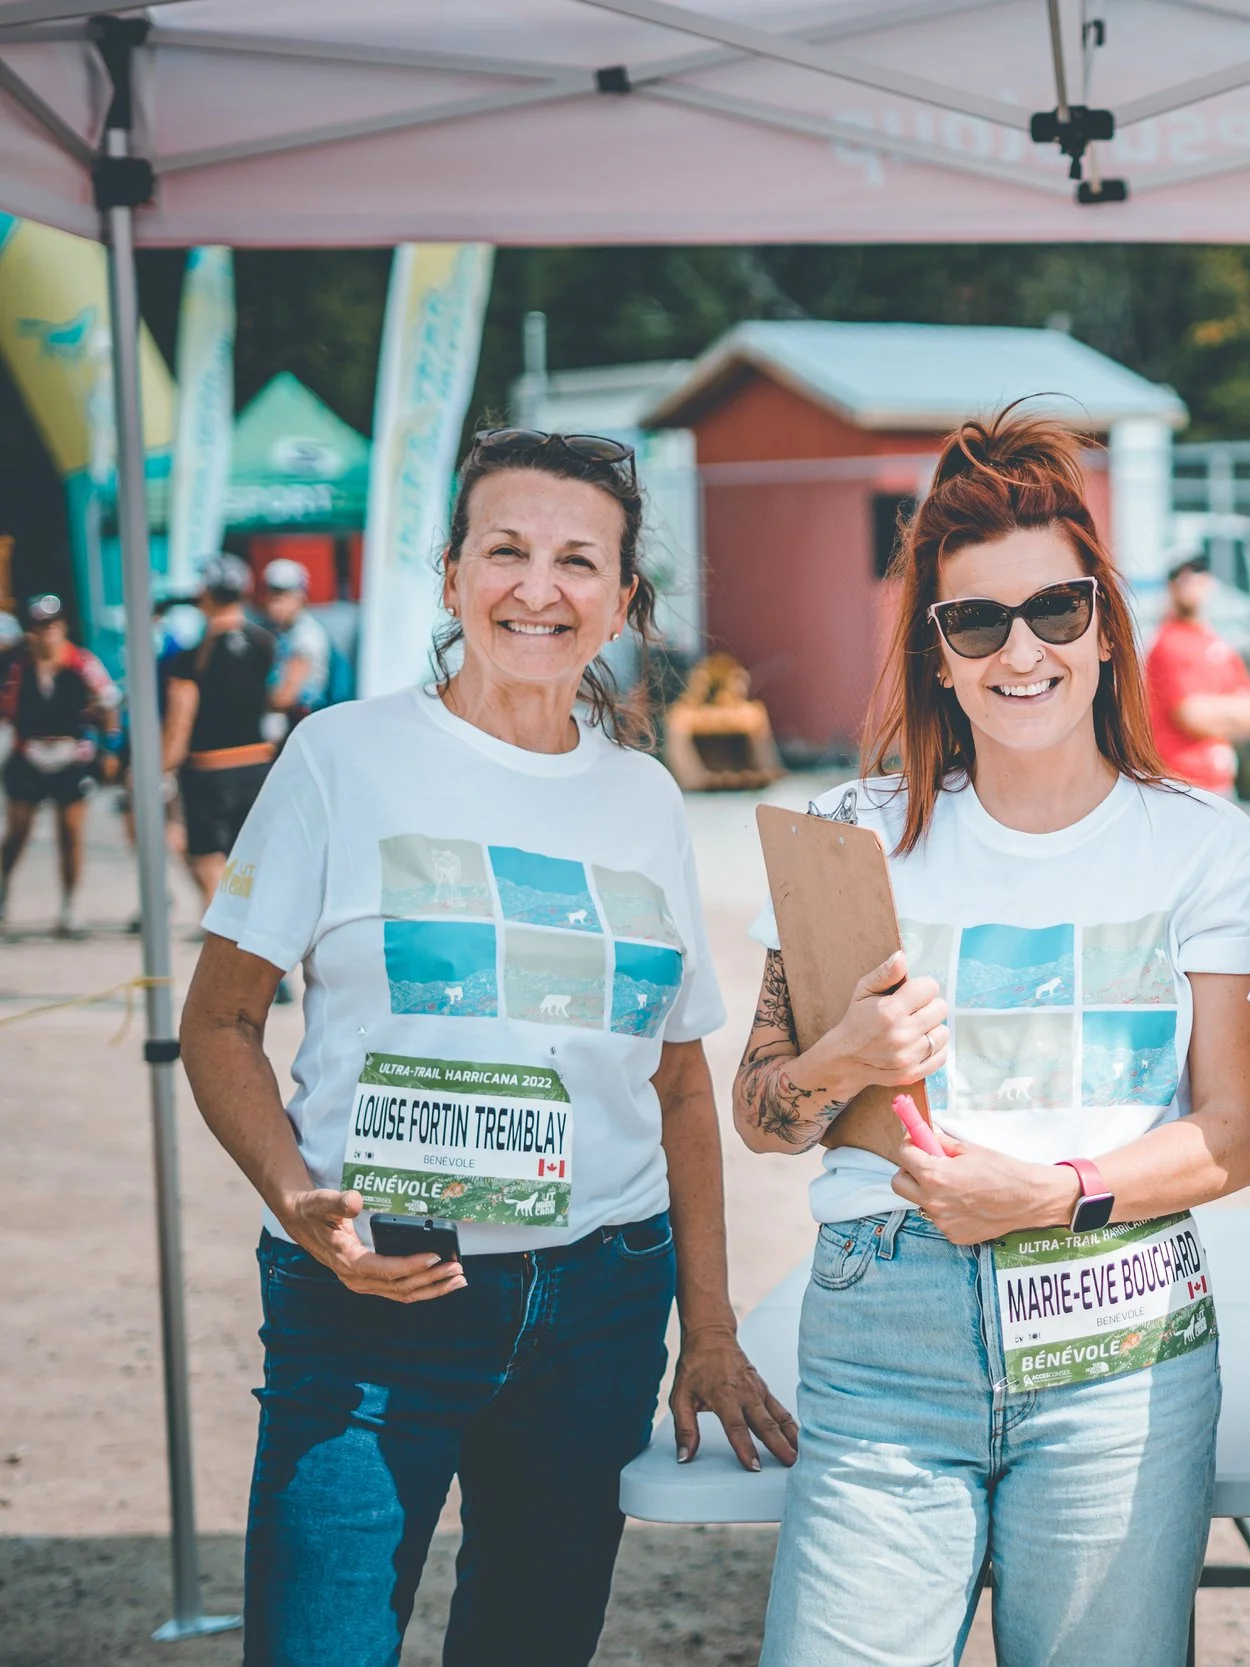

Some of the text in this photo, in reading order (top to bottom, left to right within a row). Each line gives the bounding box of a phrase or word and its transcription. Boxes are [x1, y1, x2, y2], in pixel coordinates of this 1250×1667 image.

[379, 1062, 552, 1089] ULTRA-TRAIL HARRICANA 2022
[355, 1094, 567, 1154] LOUISE FORTIN TREMBLAY
[353, 1173, 443, 1199] BÉNÉVOLE
[1018, 1233, 1101, 1254] ULTRA-TRAIL
[1007, 1230, 1201, 1323] MARIE-EVE BOUCHARD
[1021, 1340, 1121, 1373] BÉNÉVOLE
